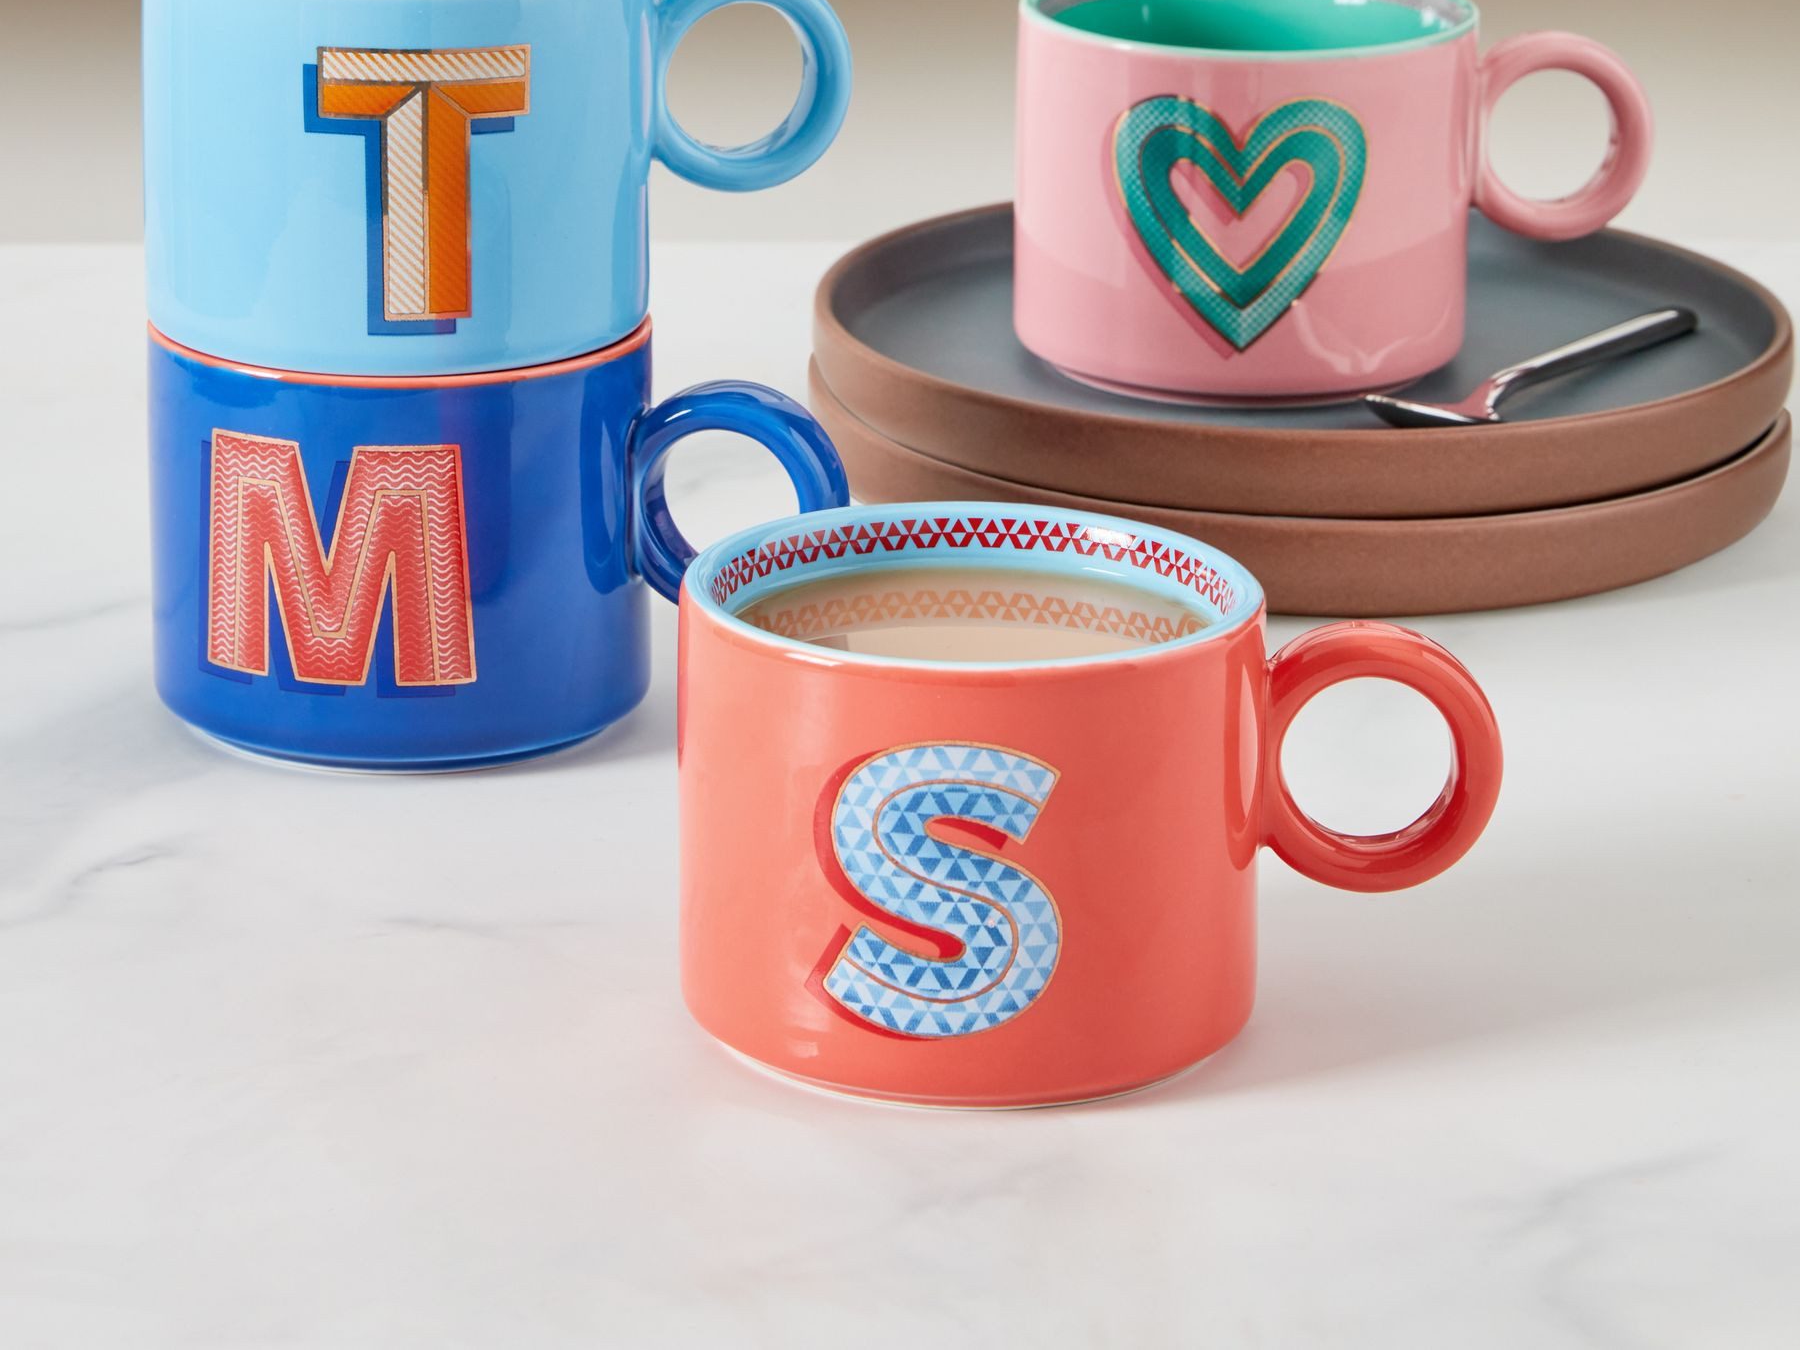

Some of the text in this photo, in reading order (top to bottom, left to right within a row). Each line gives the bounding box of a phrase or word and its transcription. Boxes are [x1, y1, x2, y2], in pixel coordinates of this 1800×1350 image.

[316, 43, 532, 322] T
[206, 427, 478, 687] M
[822, 738, 1063, 1038] S
